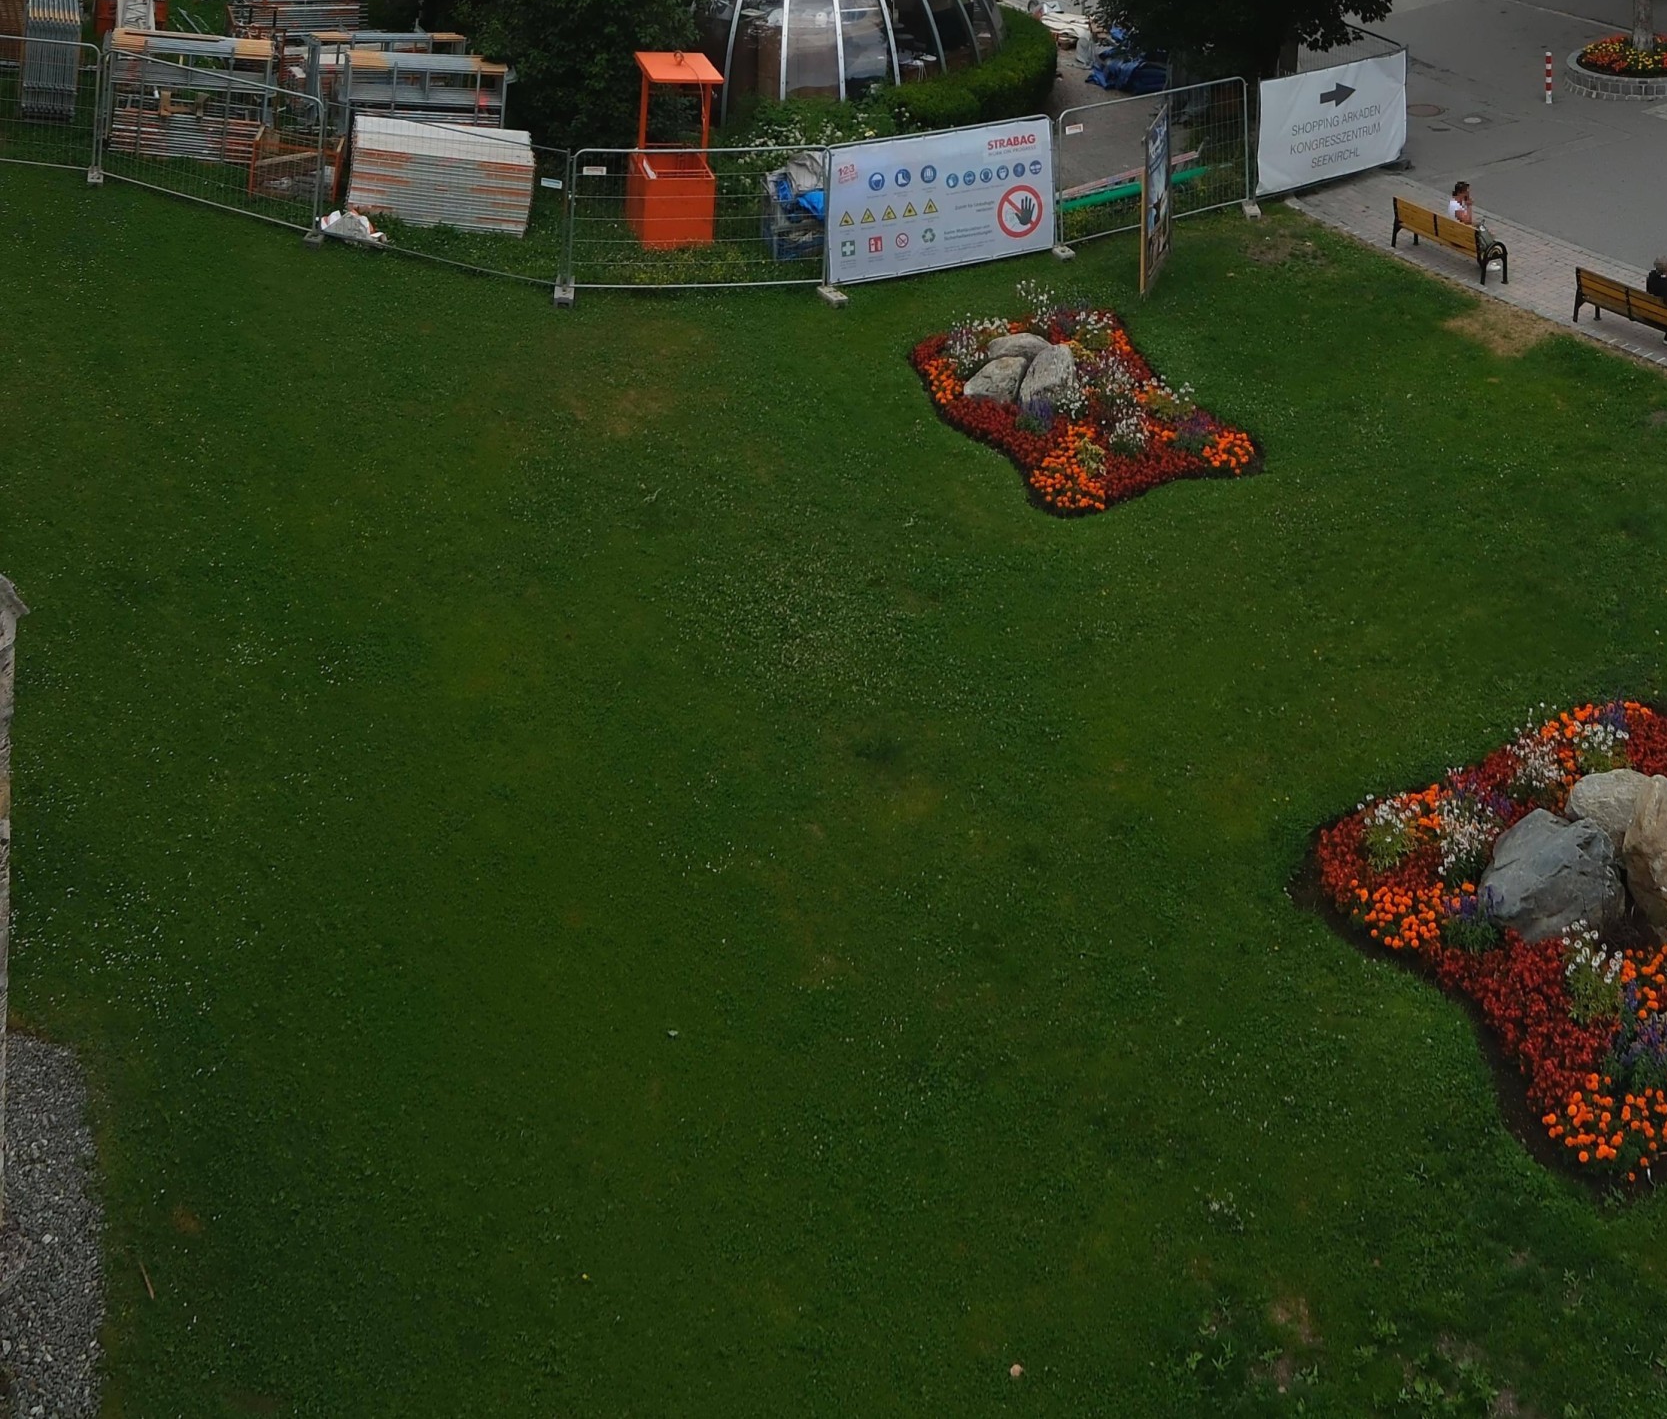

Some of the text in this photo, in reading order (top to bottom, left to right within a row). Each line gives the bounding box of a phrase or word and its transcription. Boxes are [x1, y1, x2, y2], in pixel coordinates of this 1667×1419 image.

[1291, 104, 1381, 136] SHOPPING ARKADEN
[987, 134, 1036, 151] STRABAG
[1290, 122, 1381, 155] KONGRESSZENTRUM
[1311, 147, 1360, 169] SEEKIRCHL
